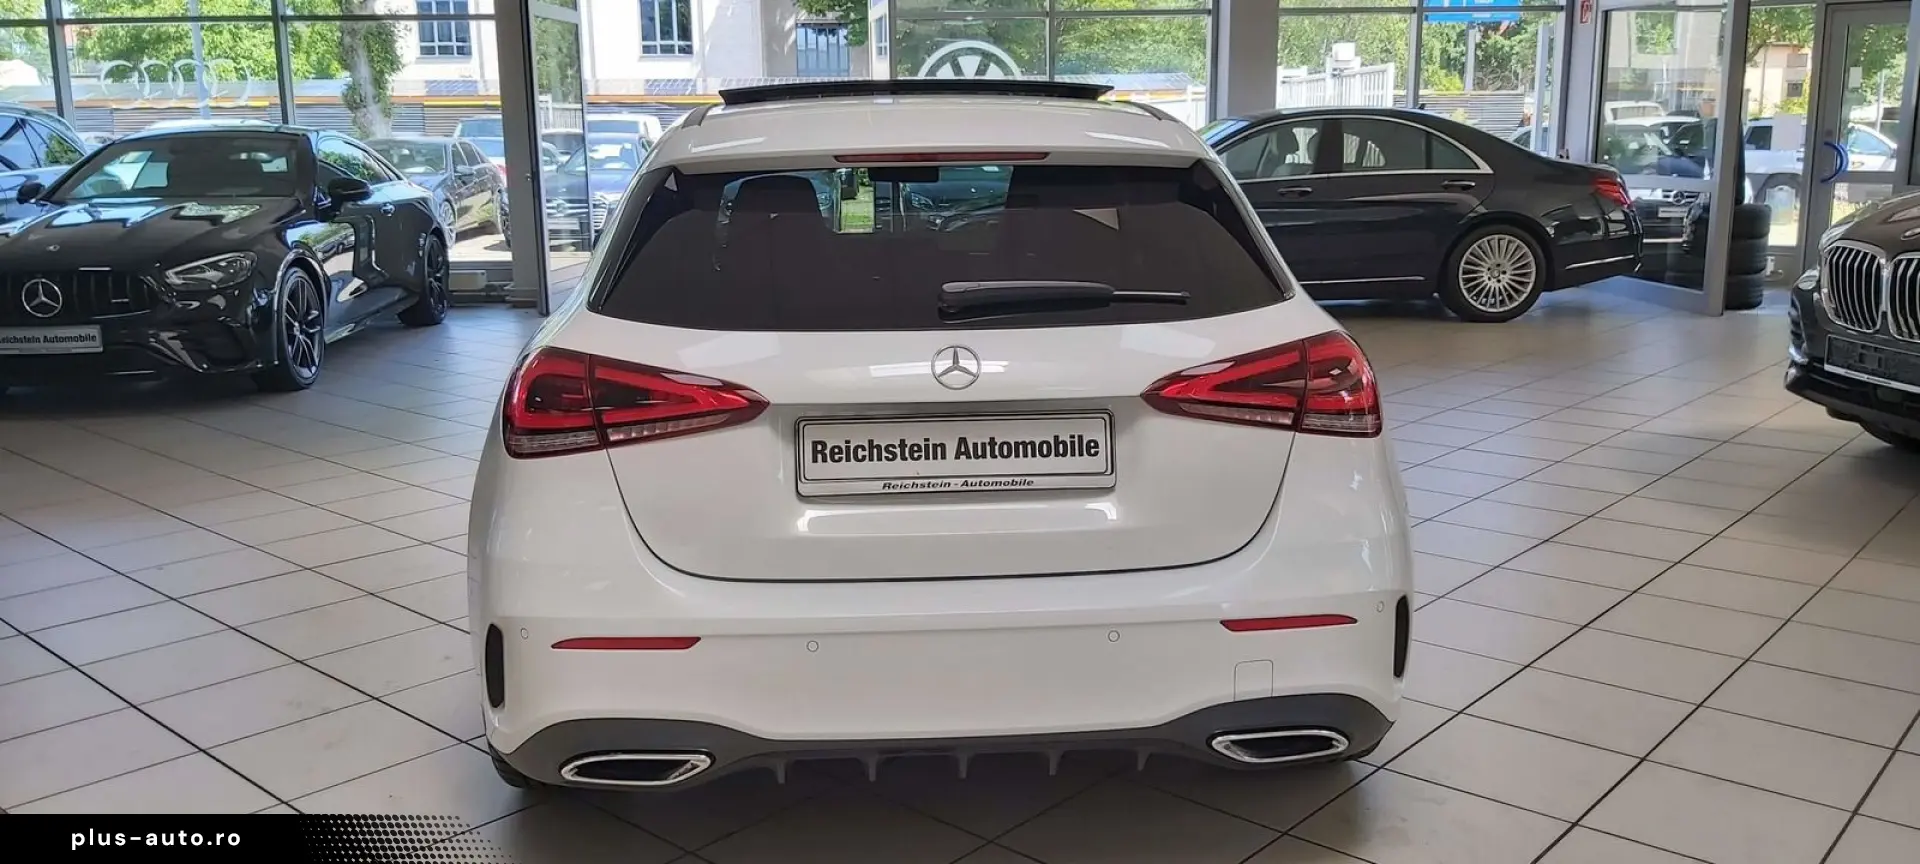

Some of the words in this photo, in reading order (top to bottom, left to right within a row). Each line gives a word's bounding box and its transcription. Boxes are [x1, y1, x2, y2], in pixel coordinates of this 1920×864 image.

[0, 335, 41, 344] eichstein
[43, 333, 97, 343] Automobile
[811, 437, 947, 463] Reichstein
[954, 434, 1100, 460] Automobile
